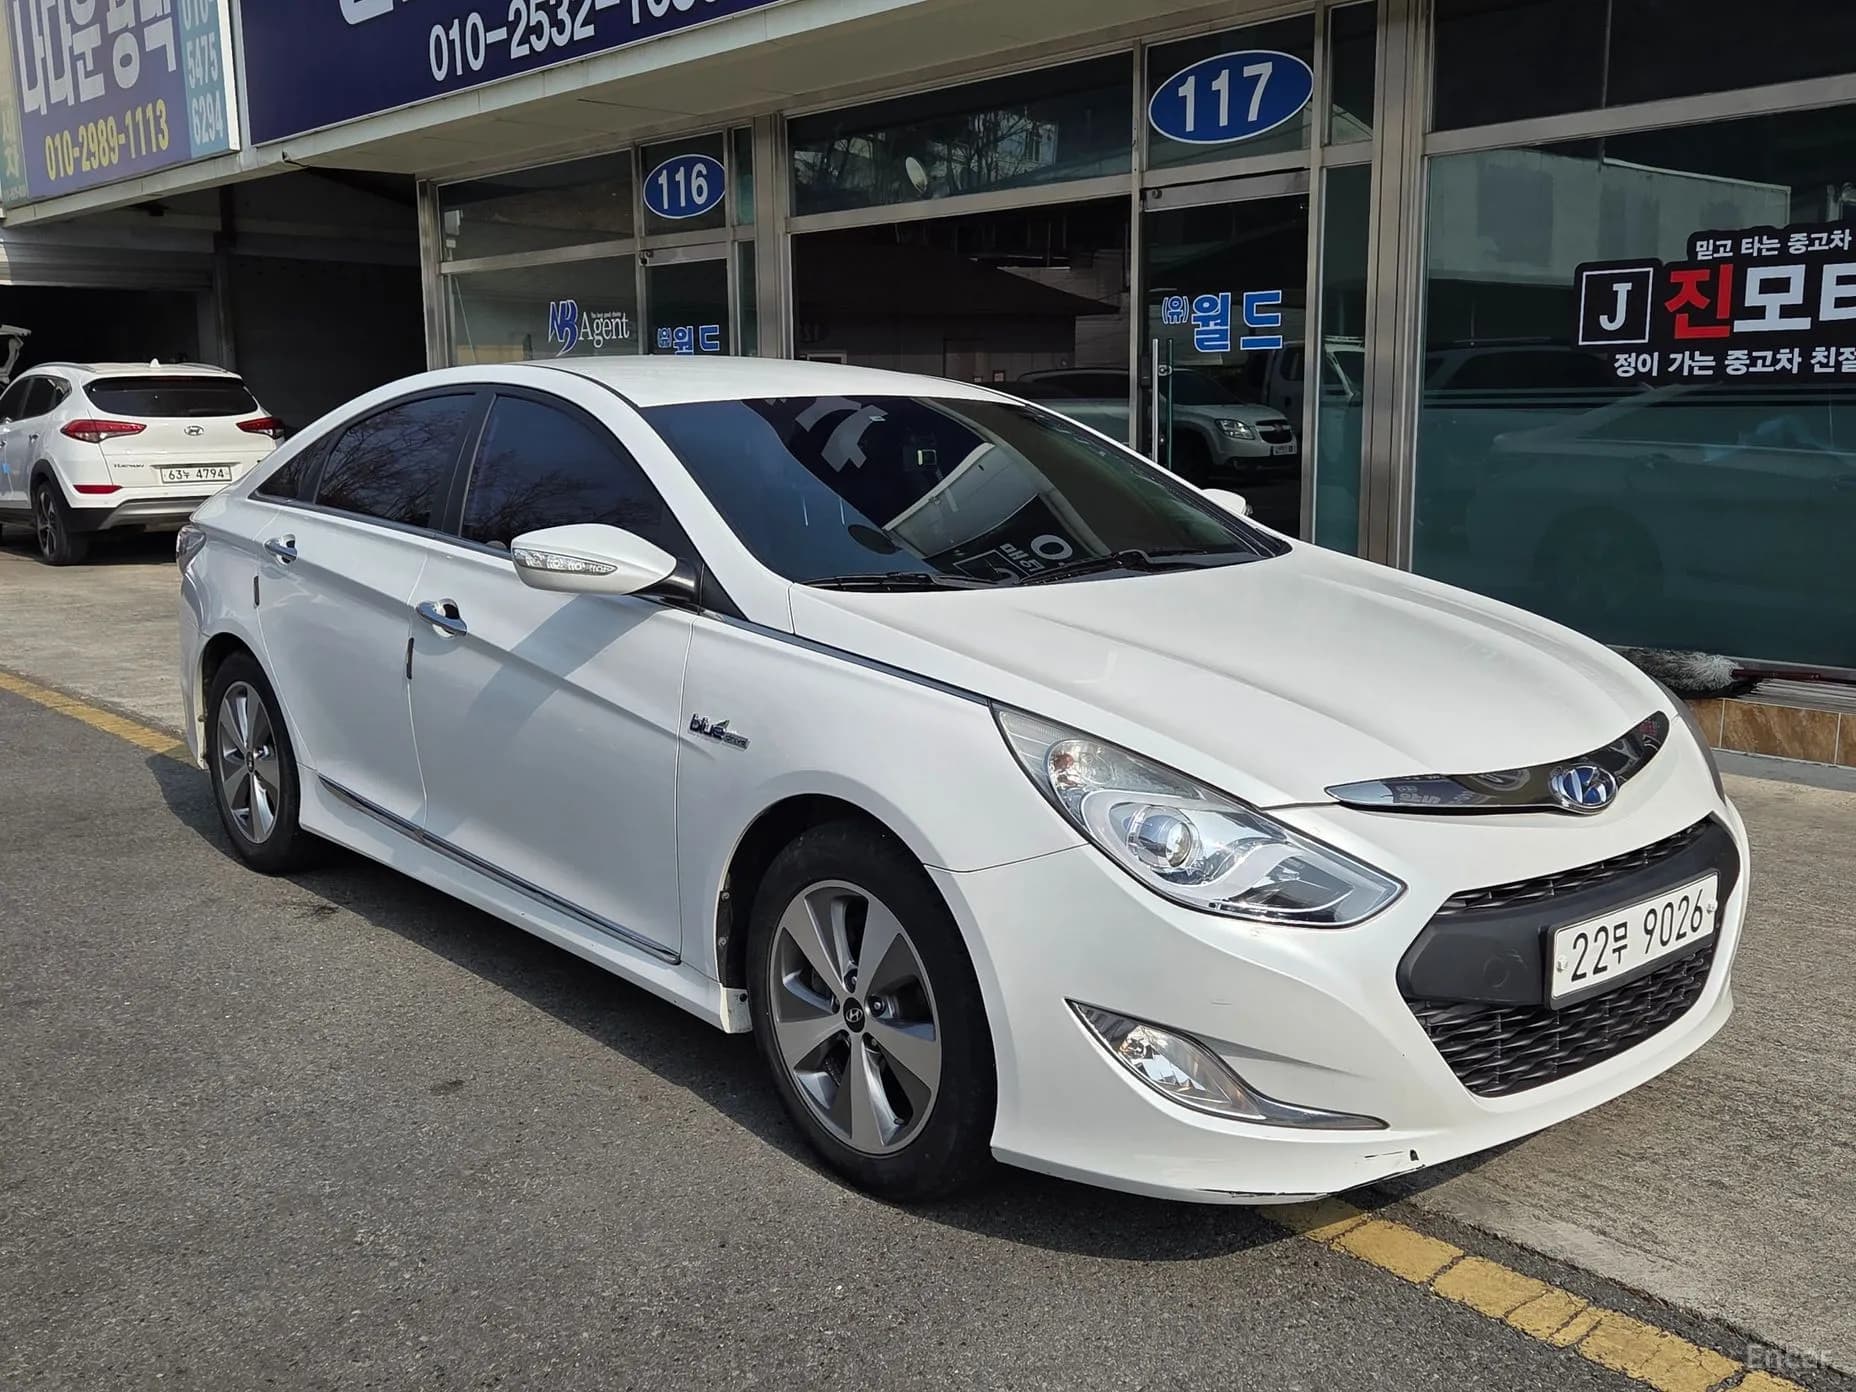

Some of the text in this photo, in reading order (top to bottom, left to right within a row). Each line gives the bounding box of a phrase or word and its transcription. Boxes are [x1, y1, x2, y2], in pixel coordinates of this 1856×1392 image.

[186, 32, 219, 89] 5475
[191, 91, 223, 146] 6294
[1177, 62, 1273, 132] 117
[45, 98, 169, 181] 010-2989-1113
[657, 162, 709, 210] 116
[1695, 229, 1852, 261] 믿고 타는 중고차
[578, 311, 630, 348] Agent
[1599, 282, 1633, 331] J
[1614, 351, 1659, 377] 정이
[1667, 350, 1716, 376] 가는
[1724, 348, 1802, 376] 중고차
[196, 468, 224, 479] 4794
[1570, 888, 1704, 982] 22무 9026
